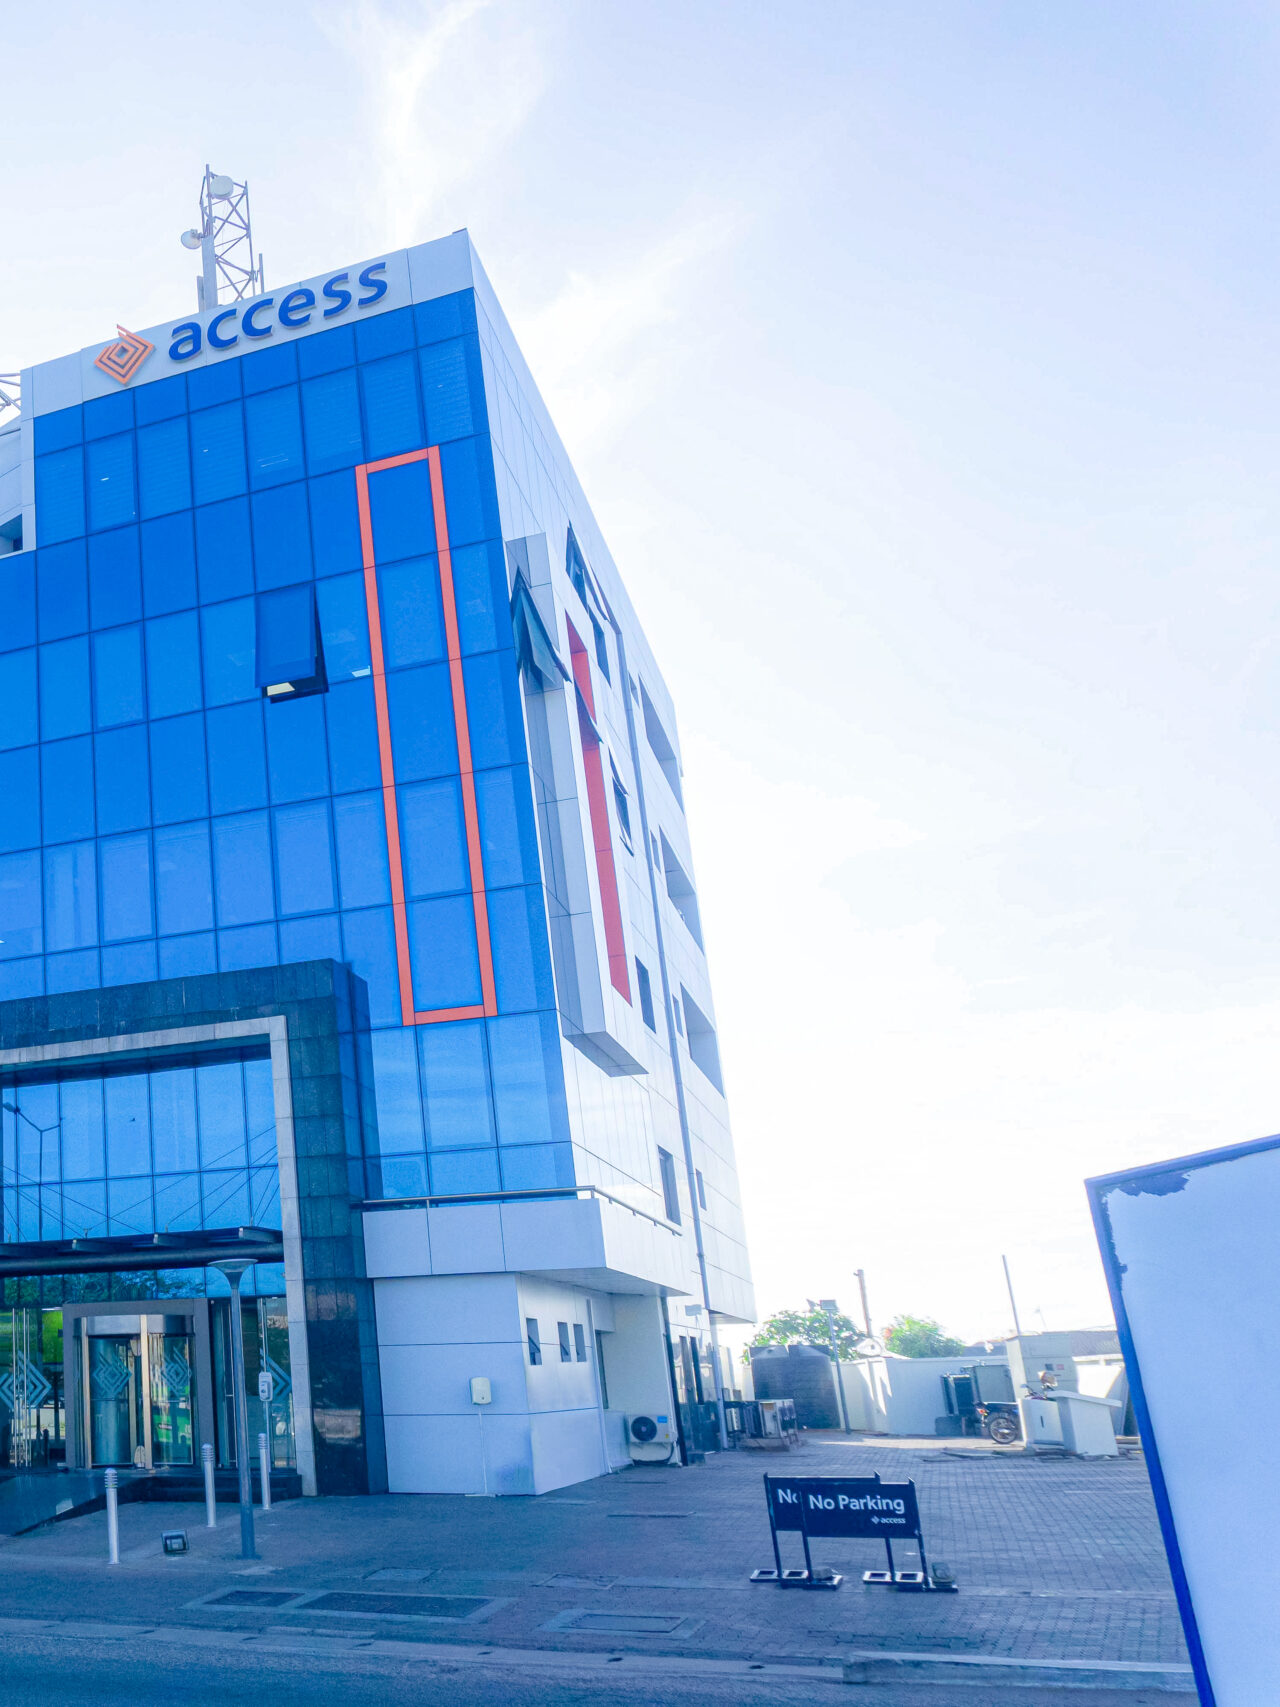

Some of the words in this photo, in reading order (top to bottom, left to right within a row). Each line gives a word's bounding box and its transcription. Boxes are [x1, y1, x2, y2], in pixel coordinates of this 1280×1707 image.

[168, 261, 388, 362] access
[808, 1494, 835, 1510] No
[838, 1494, 905, 1515] Parking
[880, 1516, 906, 1524] access
